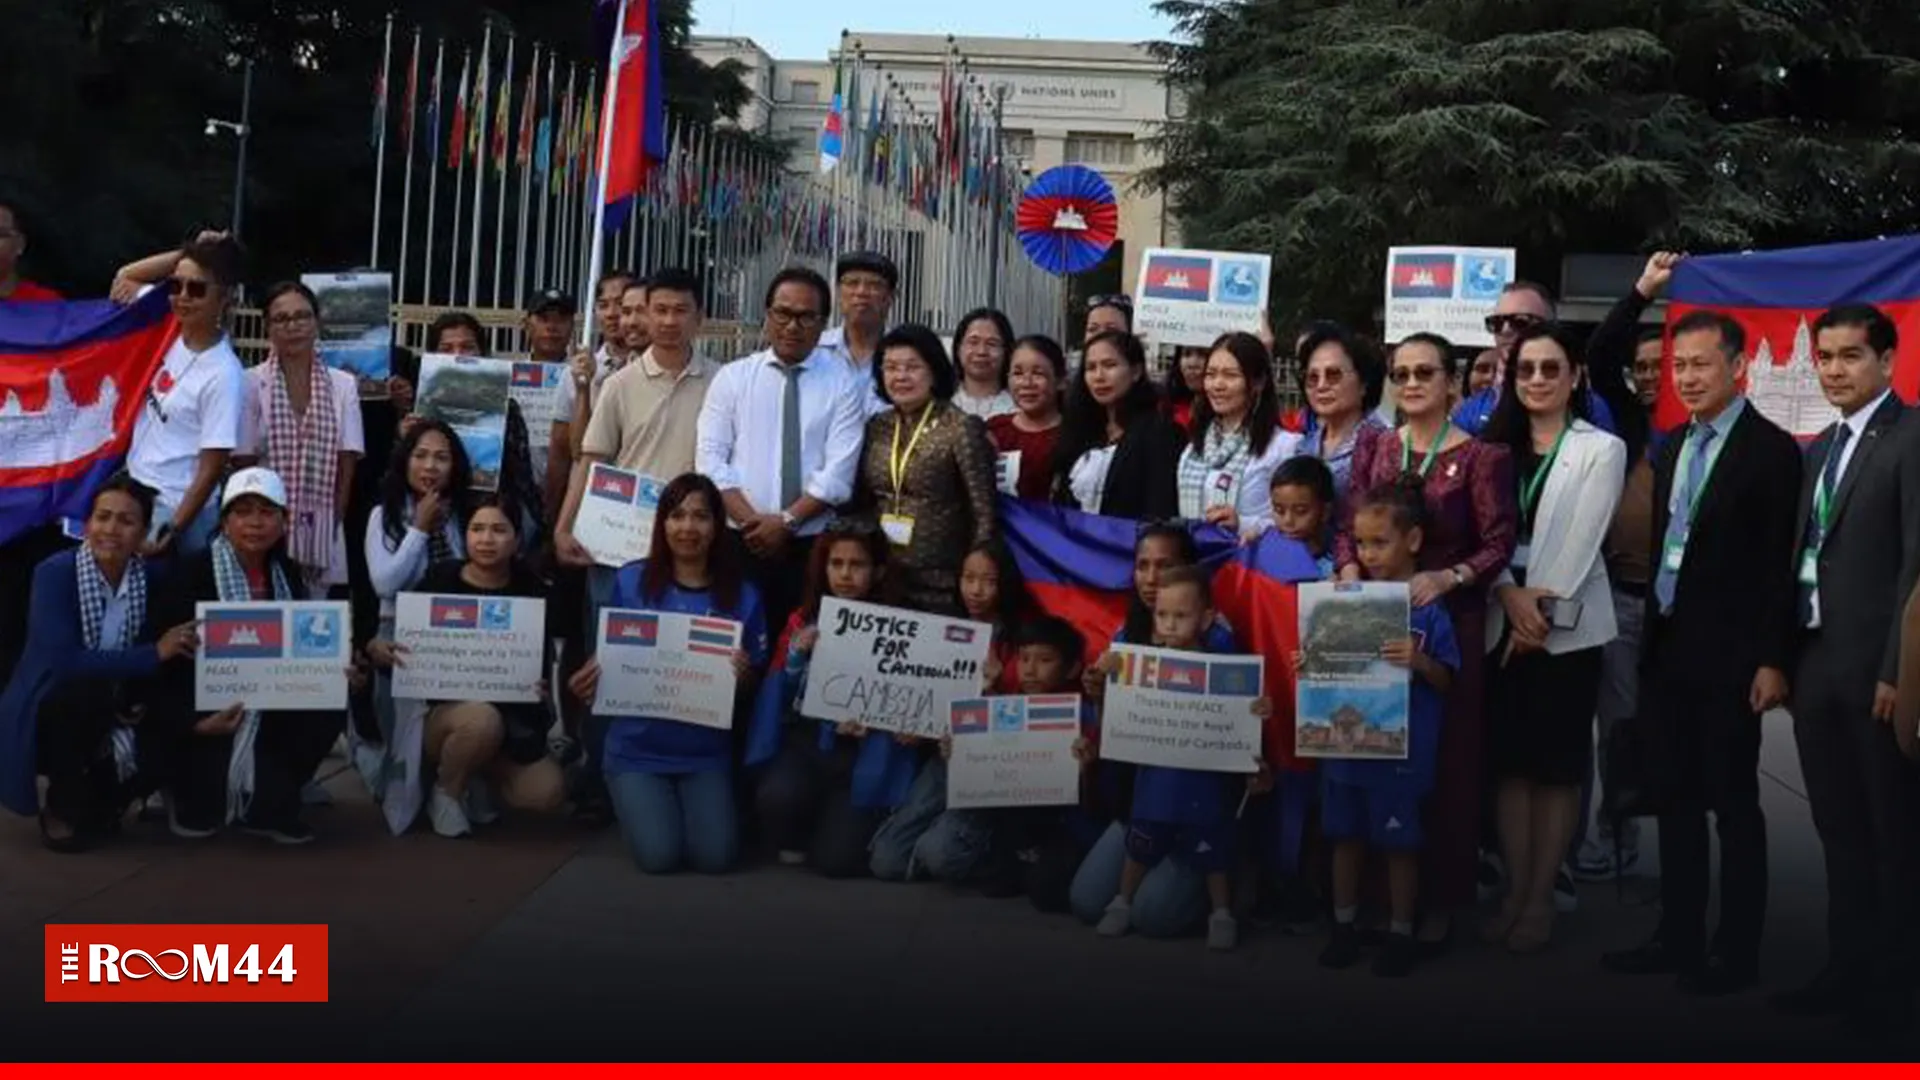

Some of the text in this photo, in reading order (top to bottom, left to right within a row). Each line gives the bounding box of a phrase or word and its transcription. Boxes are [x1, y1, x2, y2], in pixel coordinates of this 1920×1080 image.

[1021, 87, 1117, 99] NATIONS UNIES
[834, 607, 920, 637] JUSTICE
[872, 637, 910, 659] FOR
[225, 681, 259, 694] PEACE
[1193, 737, 1252, 752] Cambodia
